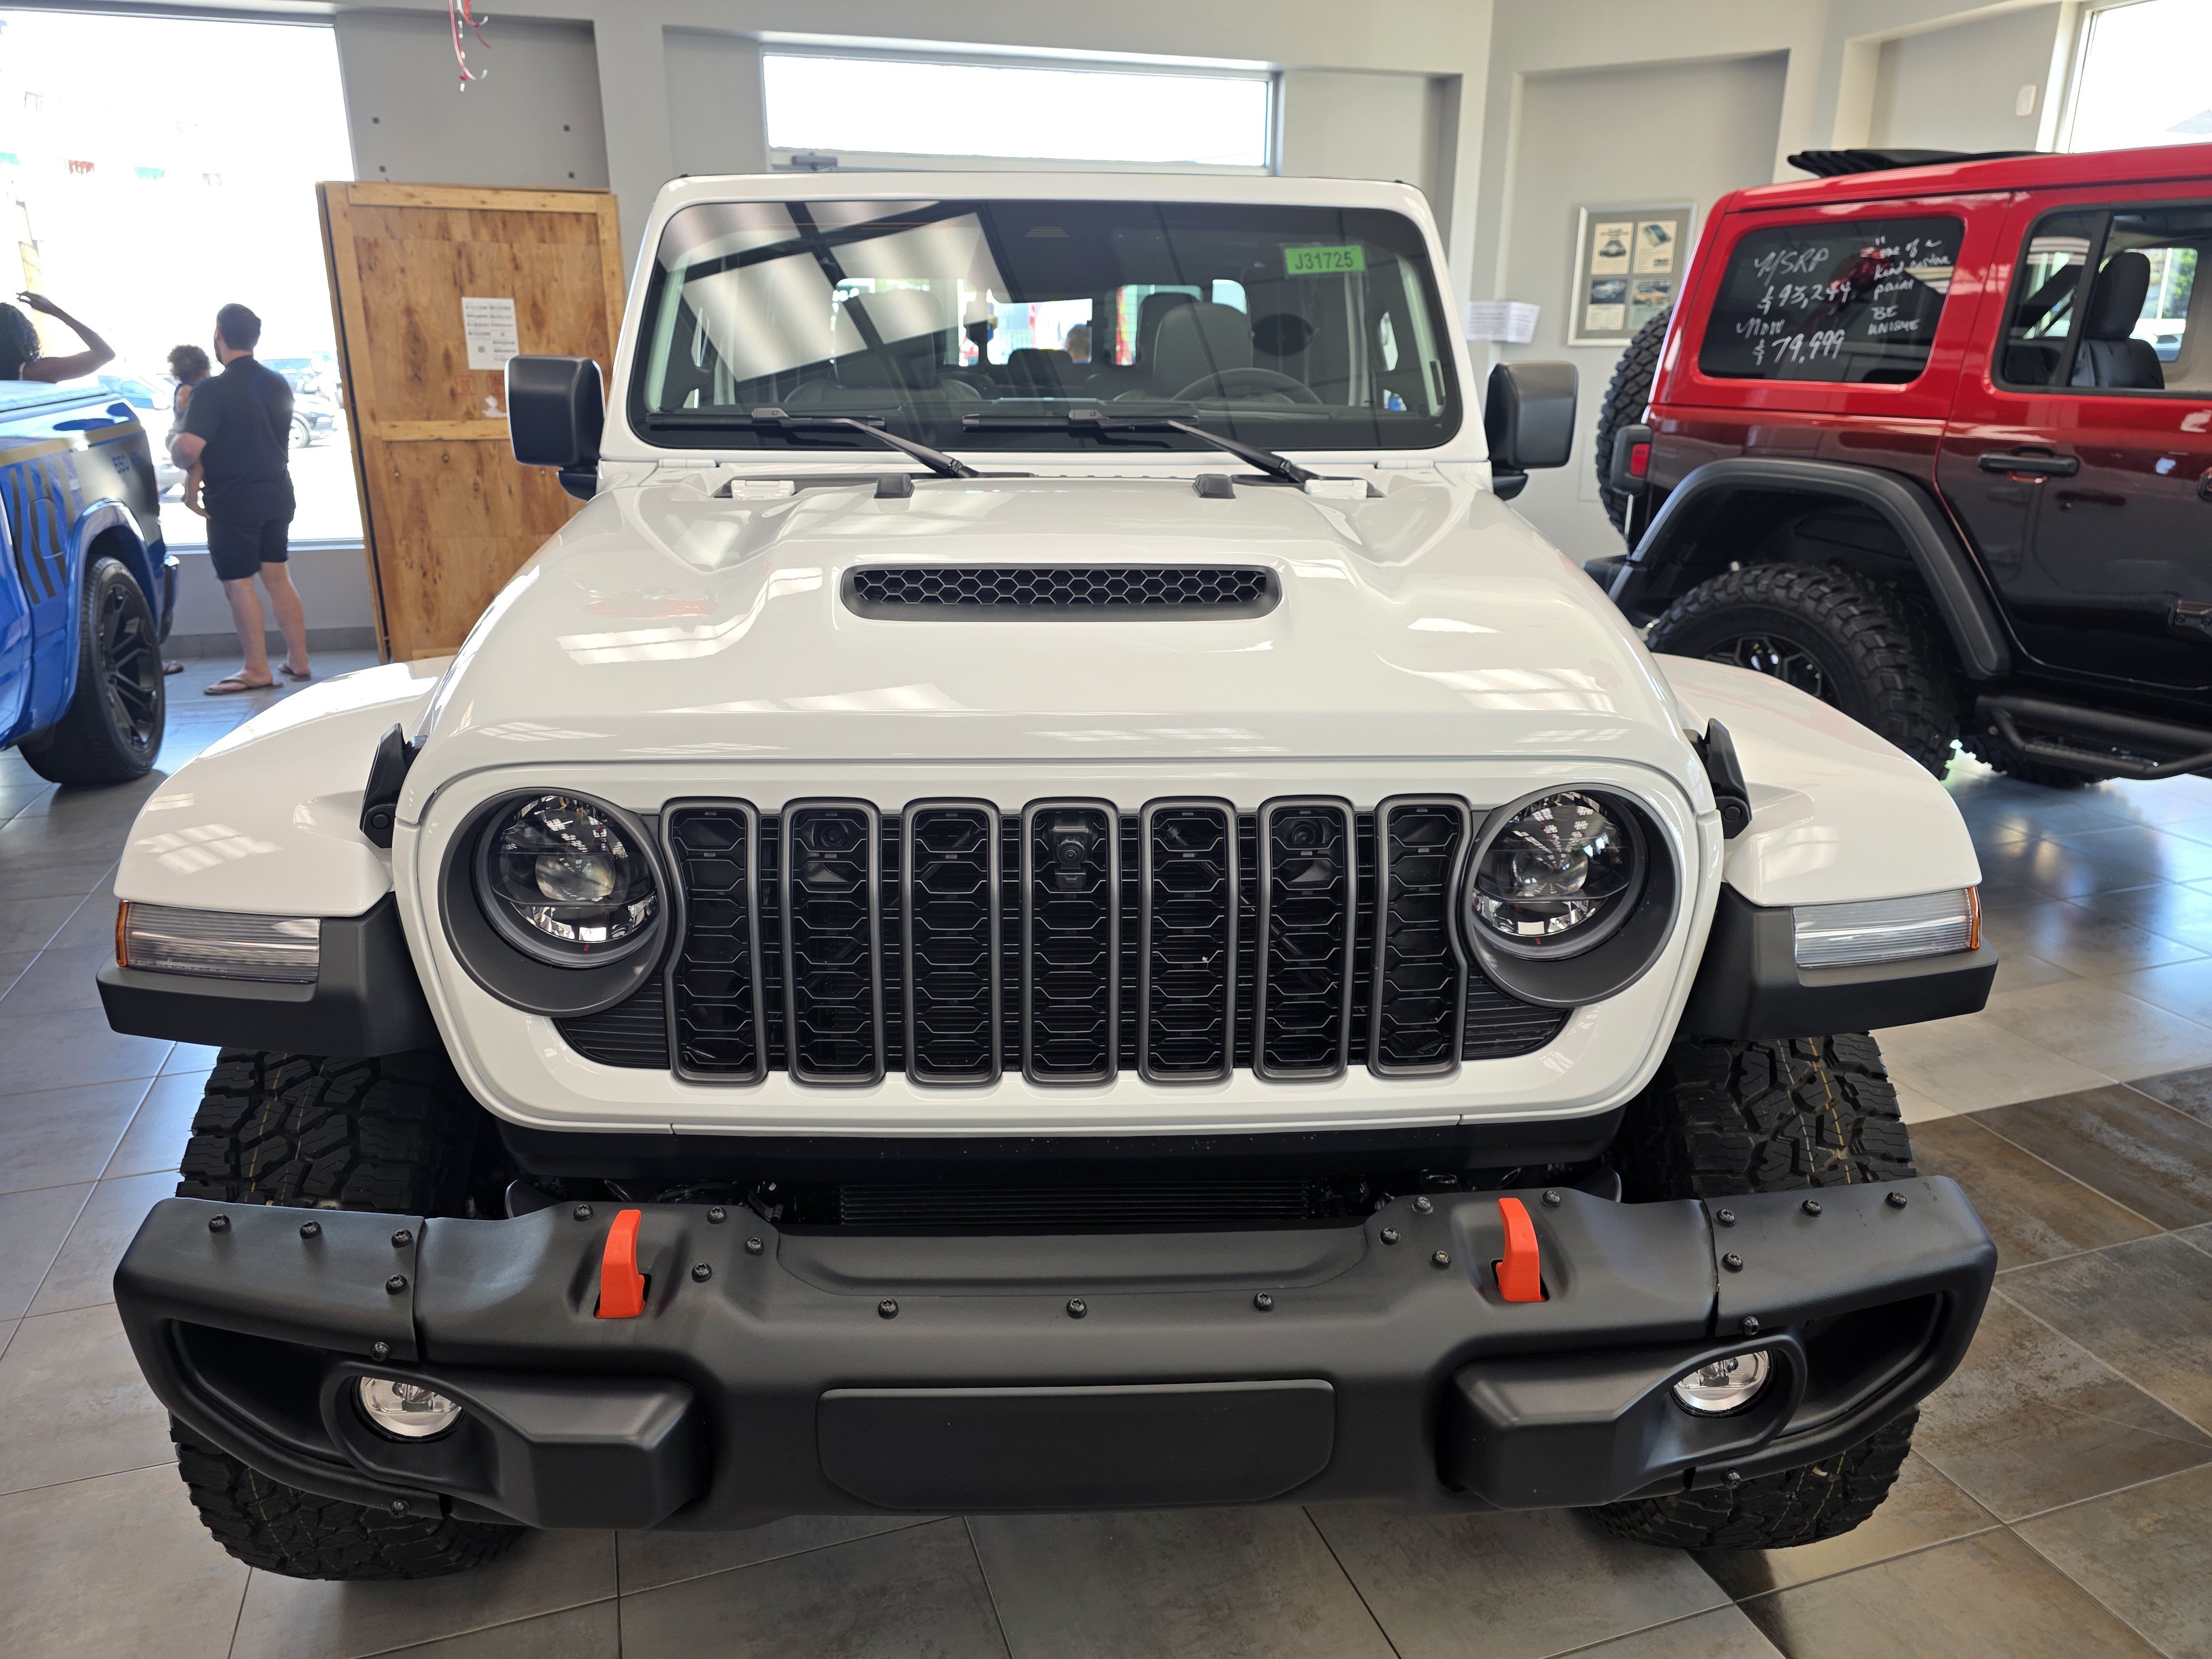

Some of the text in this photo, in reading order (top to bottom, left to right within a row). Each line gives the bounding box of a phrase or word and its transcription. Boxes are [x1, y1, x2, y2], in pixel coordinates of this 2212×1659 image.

[1906, 238, 1920, 258] of
[1295, 252, 1354, 269] J31725
[1754, 248, 1829, 286] MSRP
[1871, 305, 1899, 320] BE
